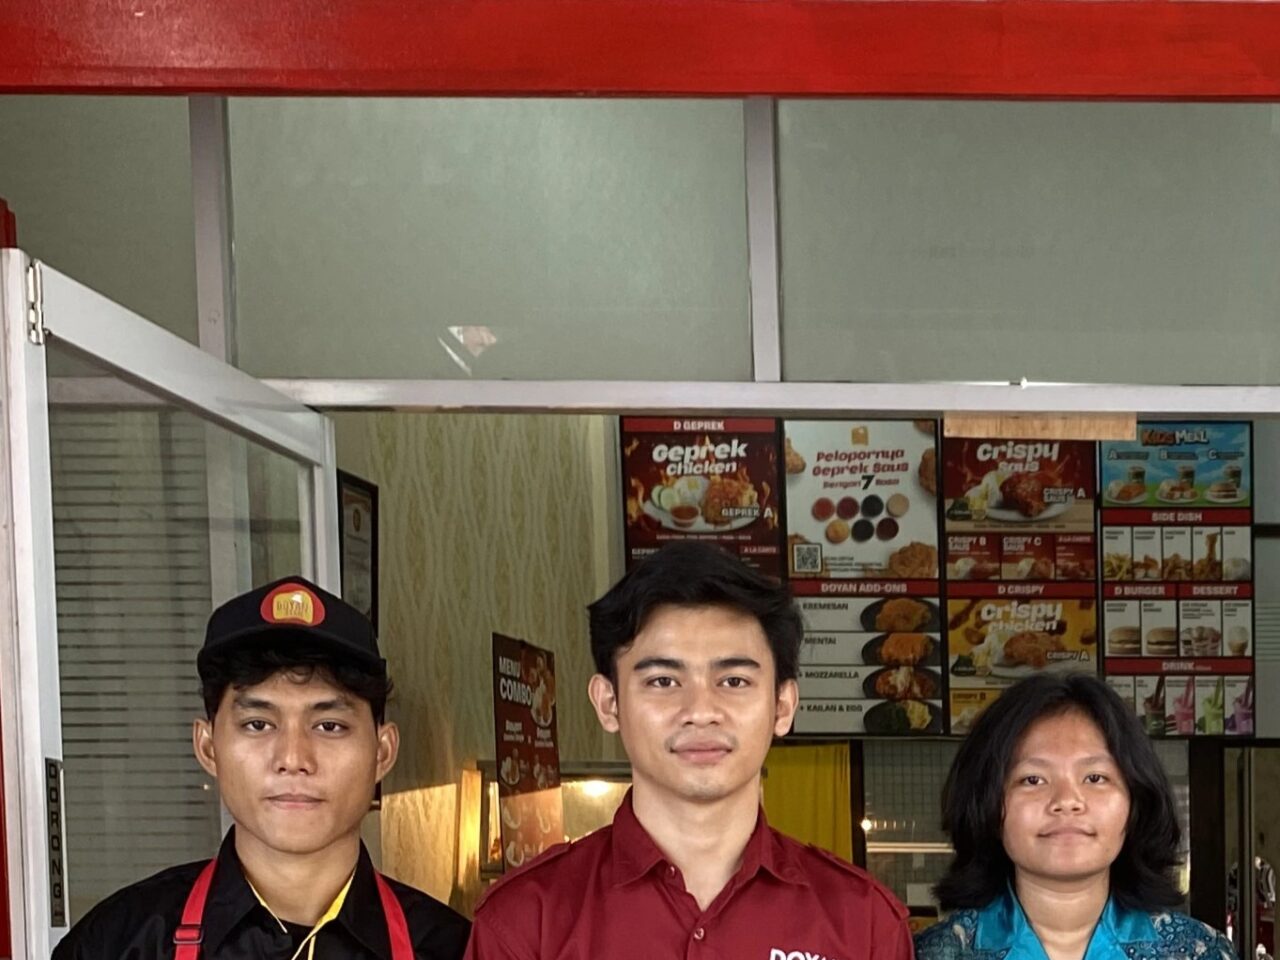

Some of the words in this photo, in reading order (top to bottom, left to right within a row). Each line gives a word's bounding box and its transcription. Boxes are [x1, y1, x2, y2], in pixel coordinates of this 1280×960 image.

[673, 421, 682, 430] D
[684, 421, 724, 431] GEPREK
[652, 439, 748, 463] Geprek
[816, 449, 905, 463] Pelopornya
[976, 441, 1060, 463] Crispy
[812, 463, 868, 477] Geprek
[873, 462, 909, 473] Saus
[861, 475, 875, 490] 7
[1076, 487, 1086, 498] A
[722, 508, 759, 518] GEPREK
[763, 507, 773, 518] A
[1152, 512, 1175, 521] SIDE
[1177, 512, 1202, 521] DISH
[979, 536, 986, 546] B
[1034, 537, 1041, 546] C
[821, 583, 857, 593] DOYAN
[859, 583, 907, 593] ADD-ONS
[998, 585, 1005, 594] D
[1007, 585, 1044, 594] CRISPY
[1114, 586, 1122, 595] D
[1124, 586, 1165, 595] BURGER
[1193, 586, 1238, 595] DESSERT
[981, 600, 1063, 622] Crispy
[1080, 650, 1089, 661] A
[499, 656, 521, 679] MENU
[1162, 662, 1194, 671] DRINK
[805, 671, 859, 679] MOZZARELLA
[500, 678, 532, 706] COMBO
[807, 704, 837, 712] KAILAN
